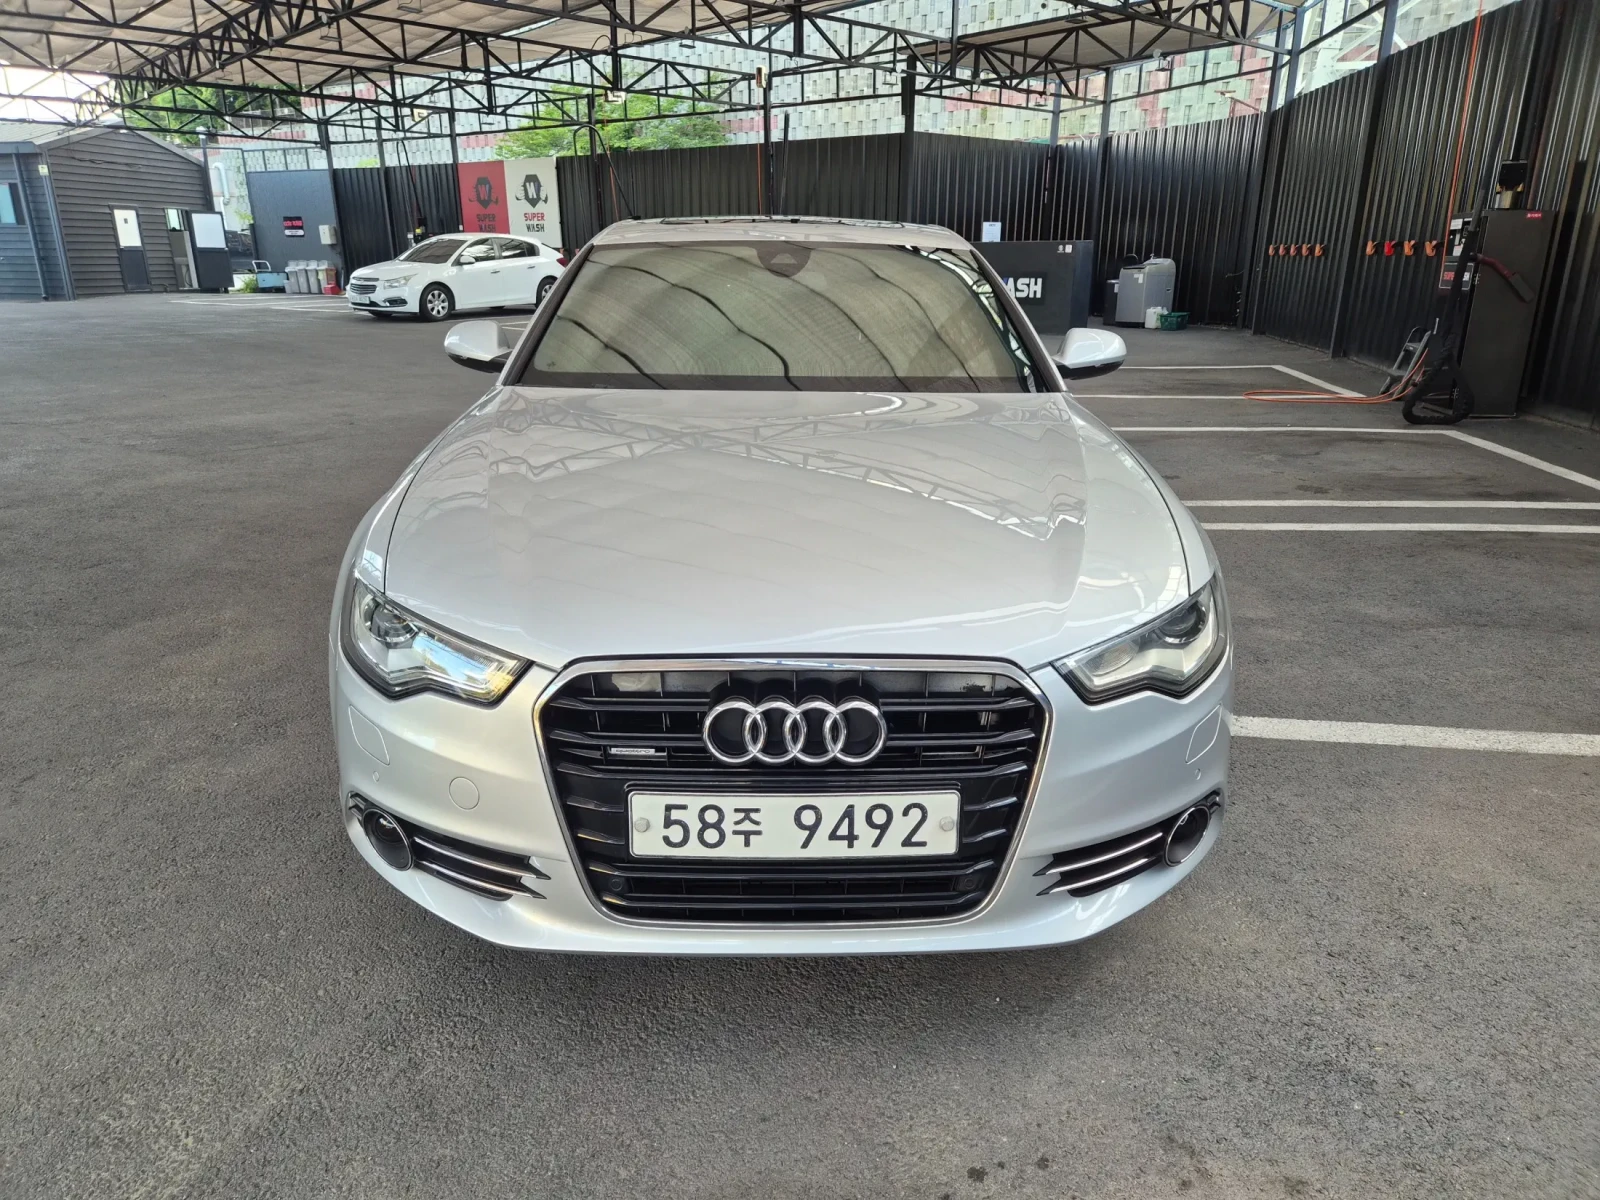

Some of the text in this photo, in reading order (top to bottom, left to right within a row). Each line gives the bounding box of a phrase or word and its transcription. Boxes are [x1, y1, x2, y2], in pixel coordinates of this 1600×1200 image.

[476, 214, 496, 222] SUPER
[524, 212, 545, 222] SUPER
[478, 224, 496, 232] WASH
[526, 224, 545, 232] WASH
[1003, 278, 1042, 298] ASH
[662, 803, 928, 849] 58주 9492
